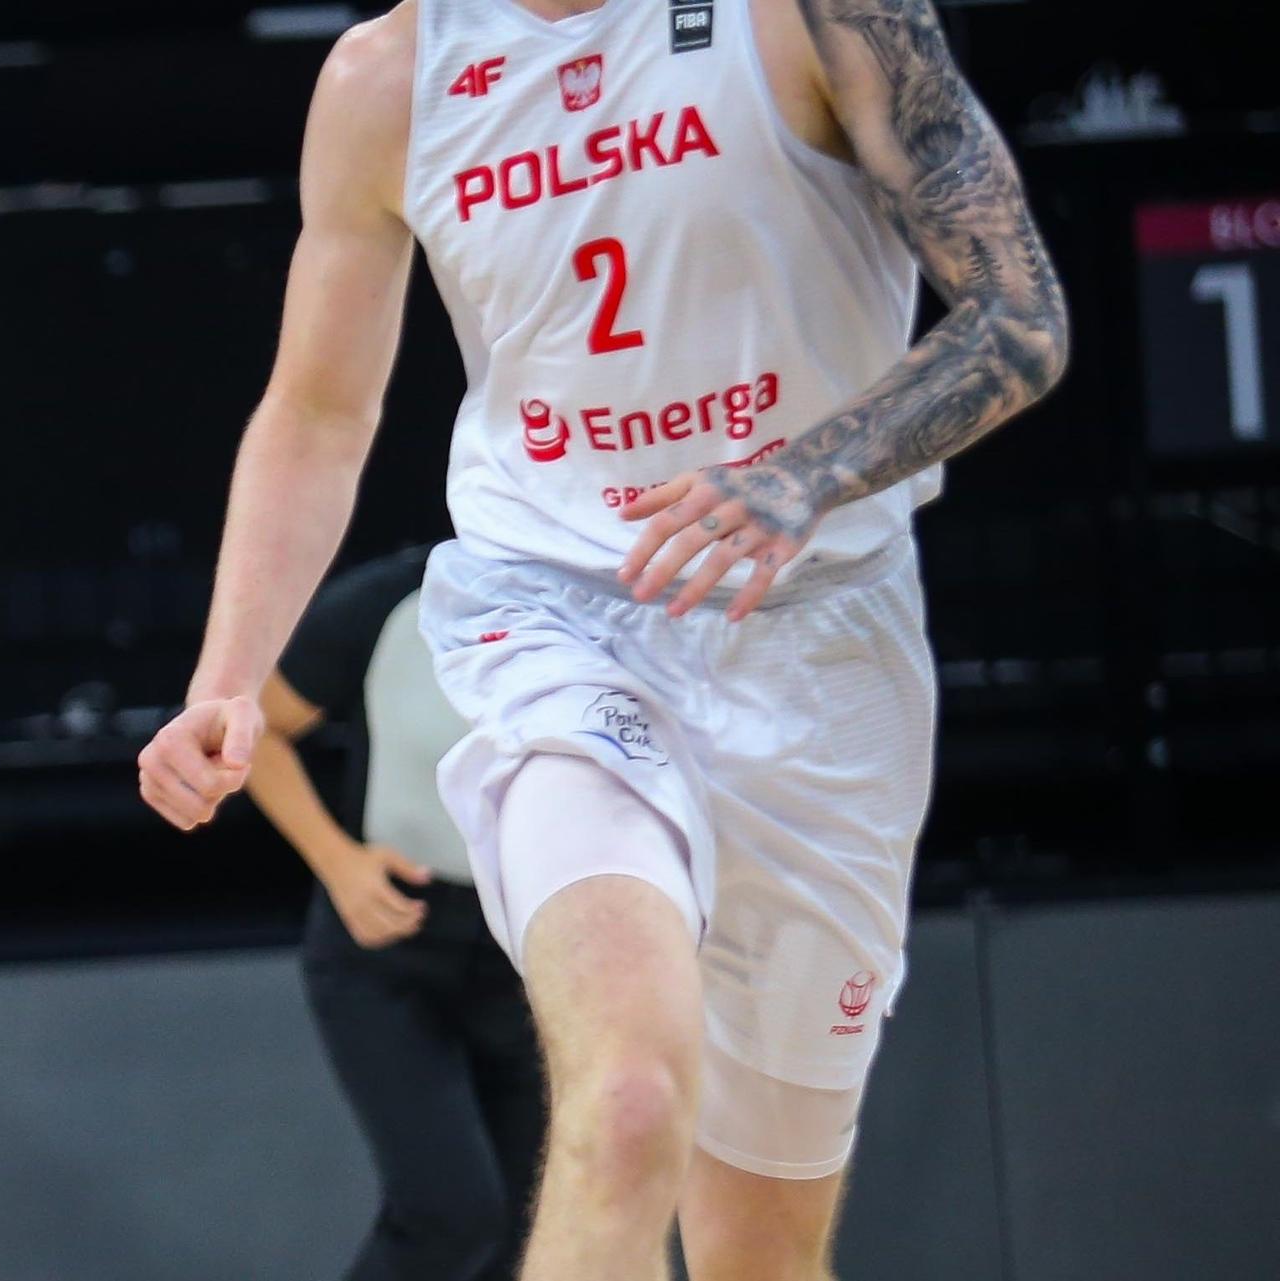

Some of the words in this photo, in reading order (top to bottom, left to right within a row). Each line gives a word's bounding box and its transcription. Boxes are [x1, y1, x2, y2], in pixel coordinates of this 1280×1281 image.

[675, 11, 707, 30] FIBA
[447, 56, 506, 97] 4F
[453, 105, 721, 222] POLSKA
[571, 236, 644, 355] 2
[1191, 262, 1264, 442] 1
[579, 372, 779, 452] Energa
